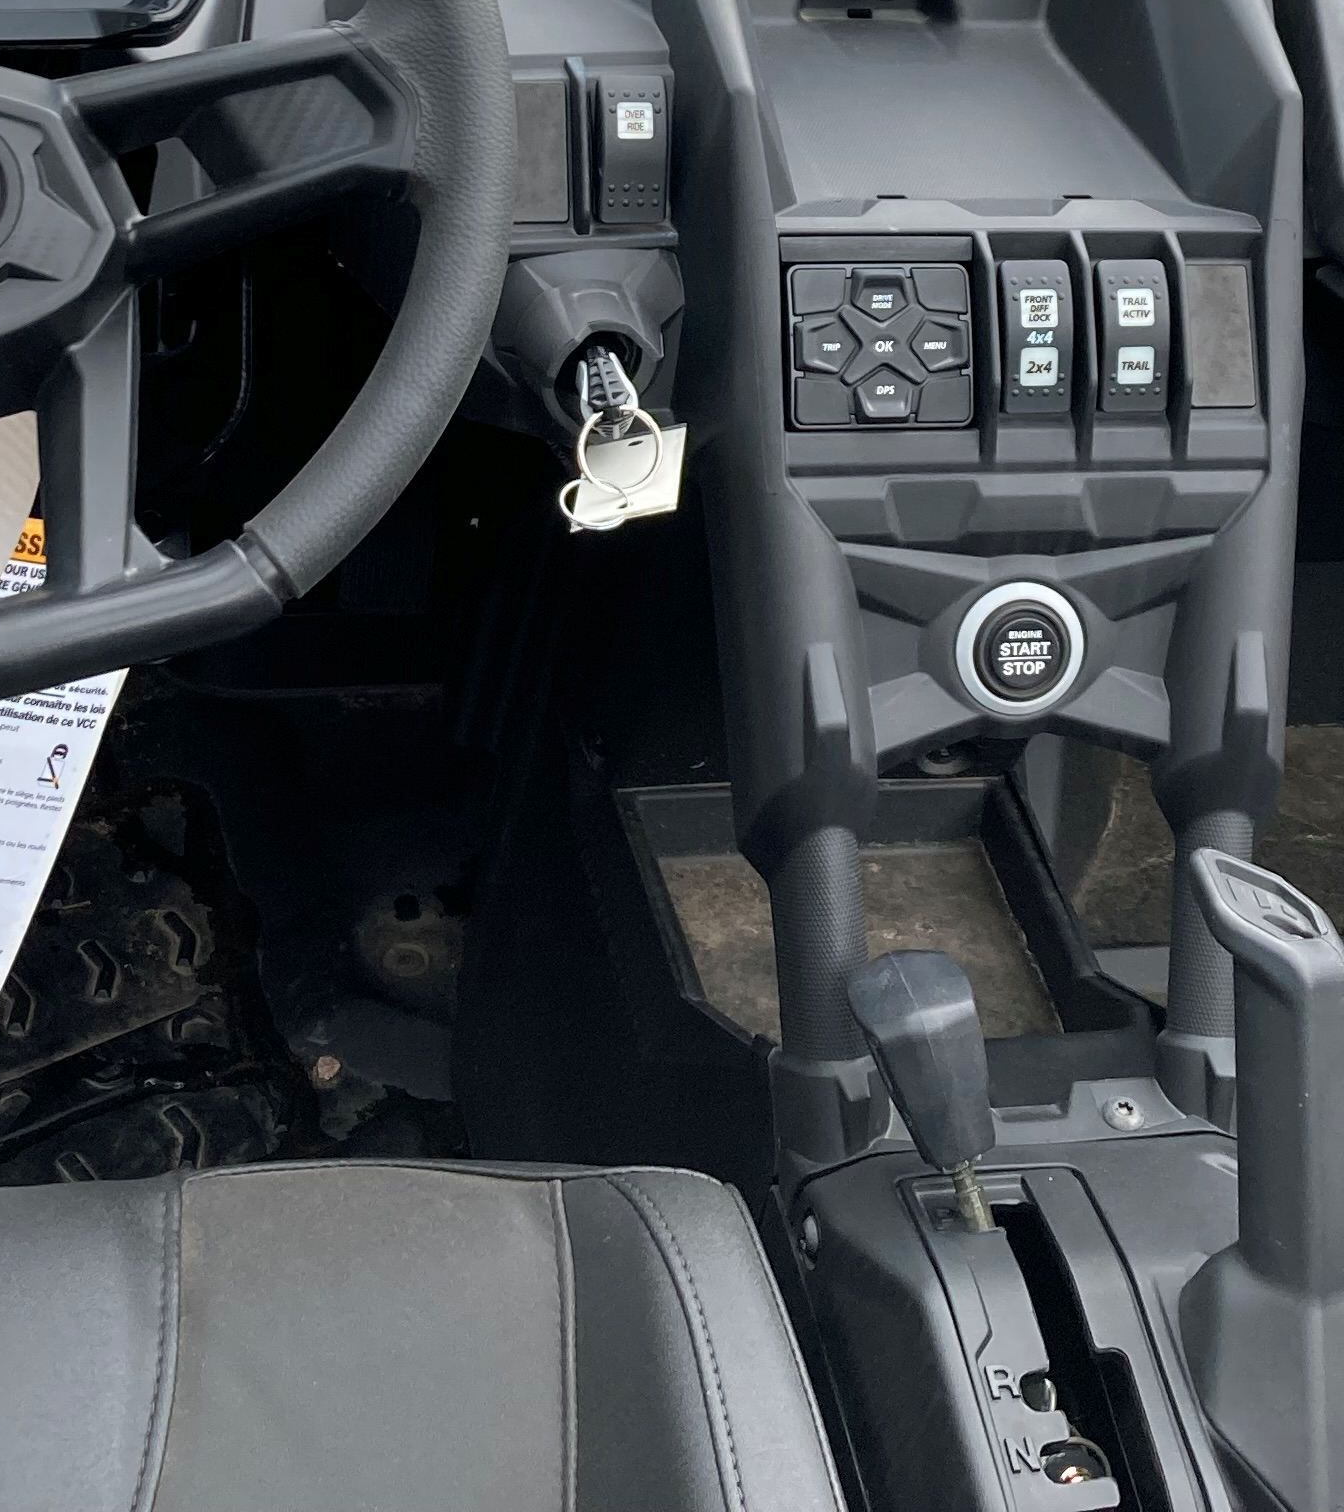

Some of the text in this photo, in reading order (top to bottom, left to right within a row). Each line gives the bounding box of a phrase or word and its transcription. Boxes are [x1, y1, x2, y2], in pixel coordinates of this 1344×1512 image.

[624, 109, 646, 119] OVER
[627, 122, 645, 131] RIDE
[872, 294, 894, 302] DRIVE
[1024, 295, 1054, 304] FRONT
[1122, 297, 1149, 306] TRAIL
[871, 301, 893, 309] MODE
[1030, 304, 1050, 313] DIFF
[1028, 314, 1051, 322] LOCK
[1122, 309, 1151, 319] ACTIV
[1026, 330, 1054, 344] 4x4
[822, 342, 841, 352] TRIP
[874, 340, 895, 353] OK
[923, 341, 948, 350] MENU
[1026, 360, 1053, 374] 2x4
[1121, 361, 1150, 371] TRAIL
[876, 385, 895, 395] DPS
[1008, 629, 1043, 640] ENGINE
[999, 641, 1052, 657] START
[1002, 660, 1046, 676] STOP
[23, 697, 72, 711] connaître
[73, 702, 89, 713] les
[89, 705, 106, 715] lois
[45, 714, 60, 725] de
[60, 718, 74, 727] ce
[76, 718, 97, 729] VCC
[984, 1364, 1022, 1400] R
[1003, 1435, 1041, 1474] N
